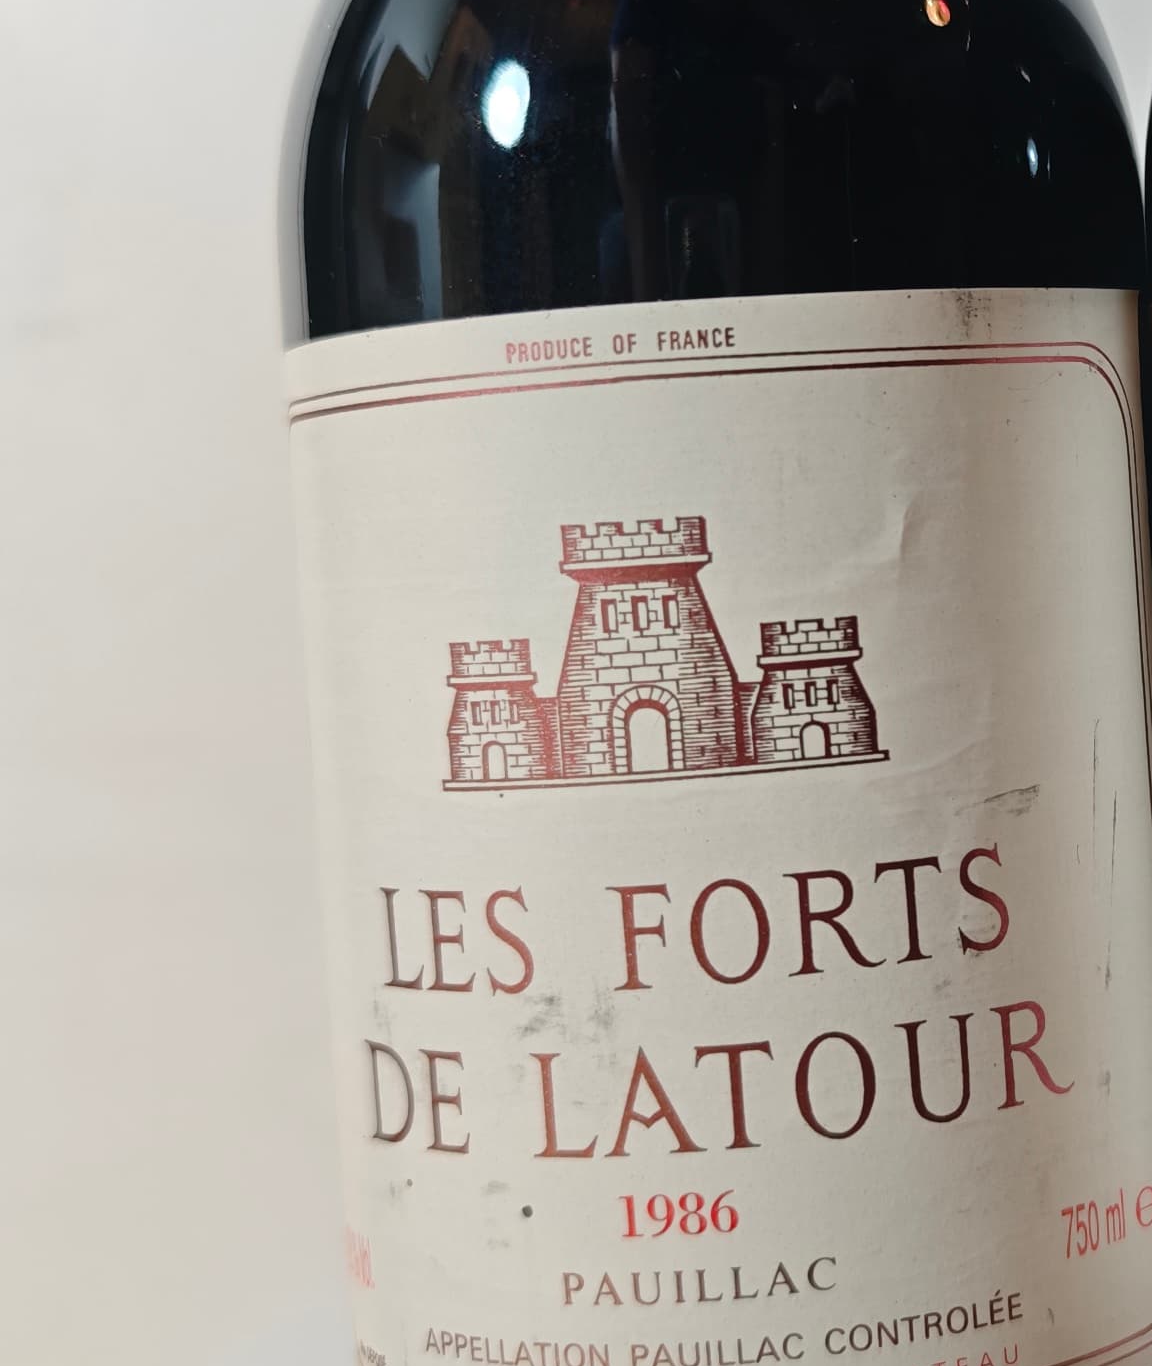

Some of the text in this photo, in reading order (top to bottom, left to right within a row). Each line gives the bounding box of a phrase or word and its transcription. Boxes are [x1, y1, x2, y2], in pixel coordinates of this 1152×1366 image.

[506, 327, 736, 363] PRODUCE OF FRANCE
[380, 843, 1011, 996] LES FORTS
[365, 1000, 1075, 1160] DE LATOUR
[617, 1189, 740, 1238] 1986
[1061, 1200, 1099, 1259] 750
[1106, 1187, 1126, 1245] ml
[562, 1257, 838, 1306] PAUILLAC
[825, 1289, 1024, 1354] CONTROLÉE
